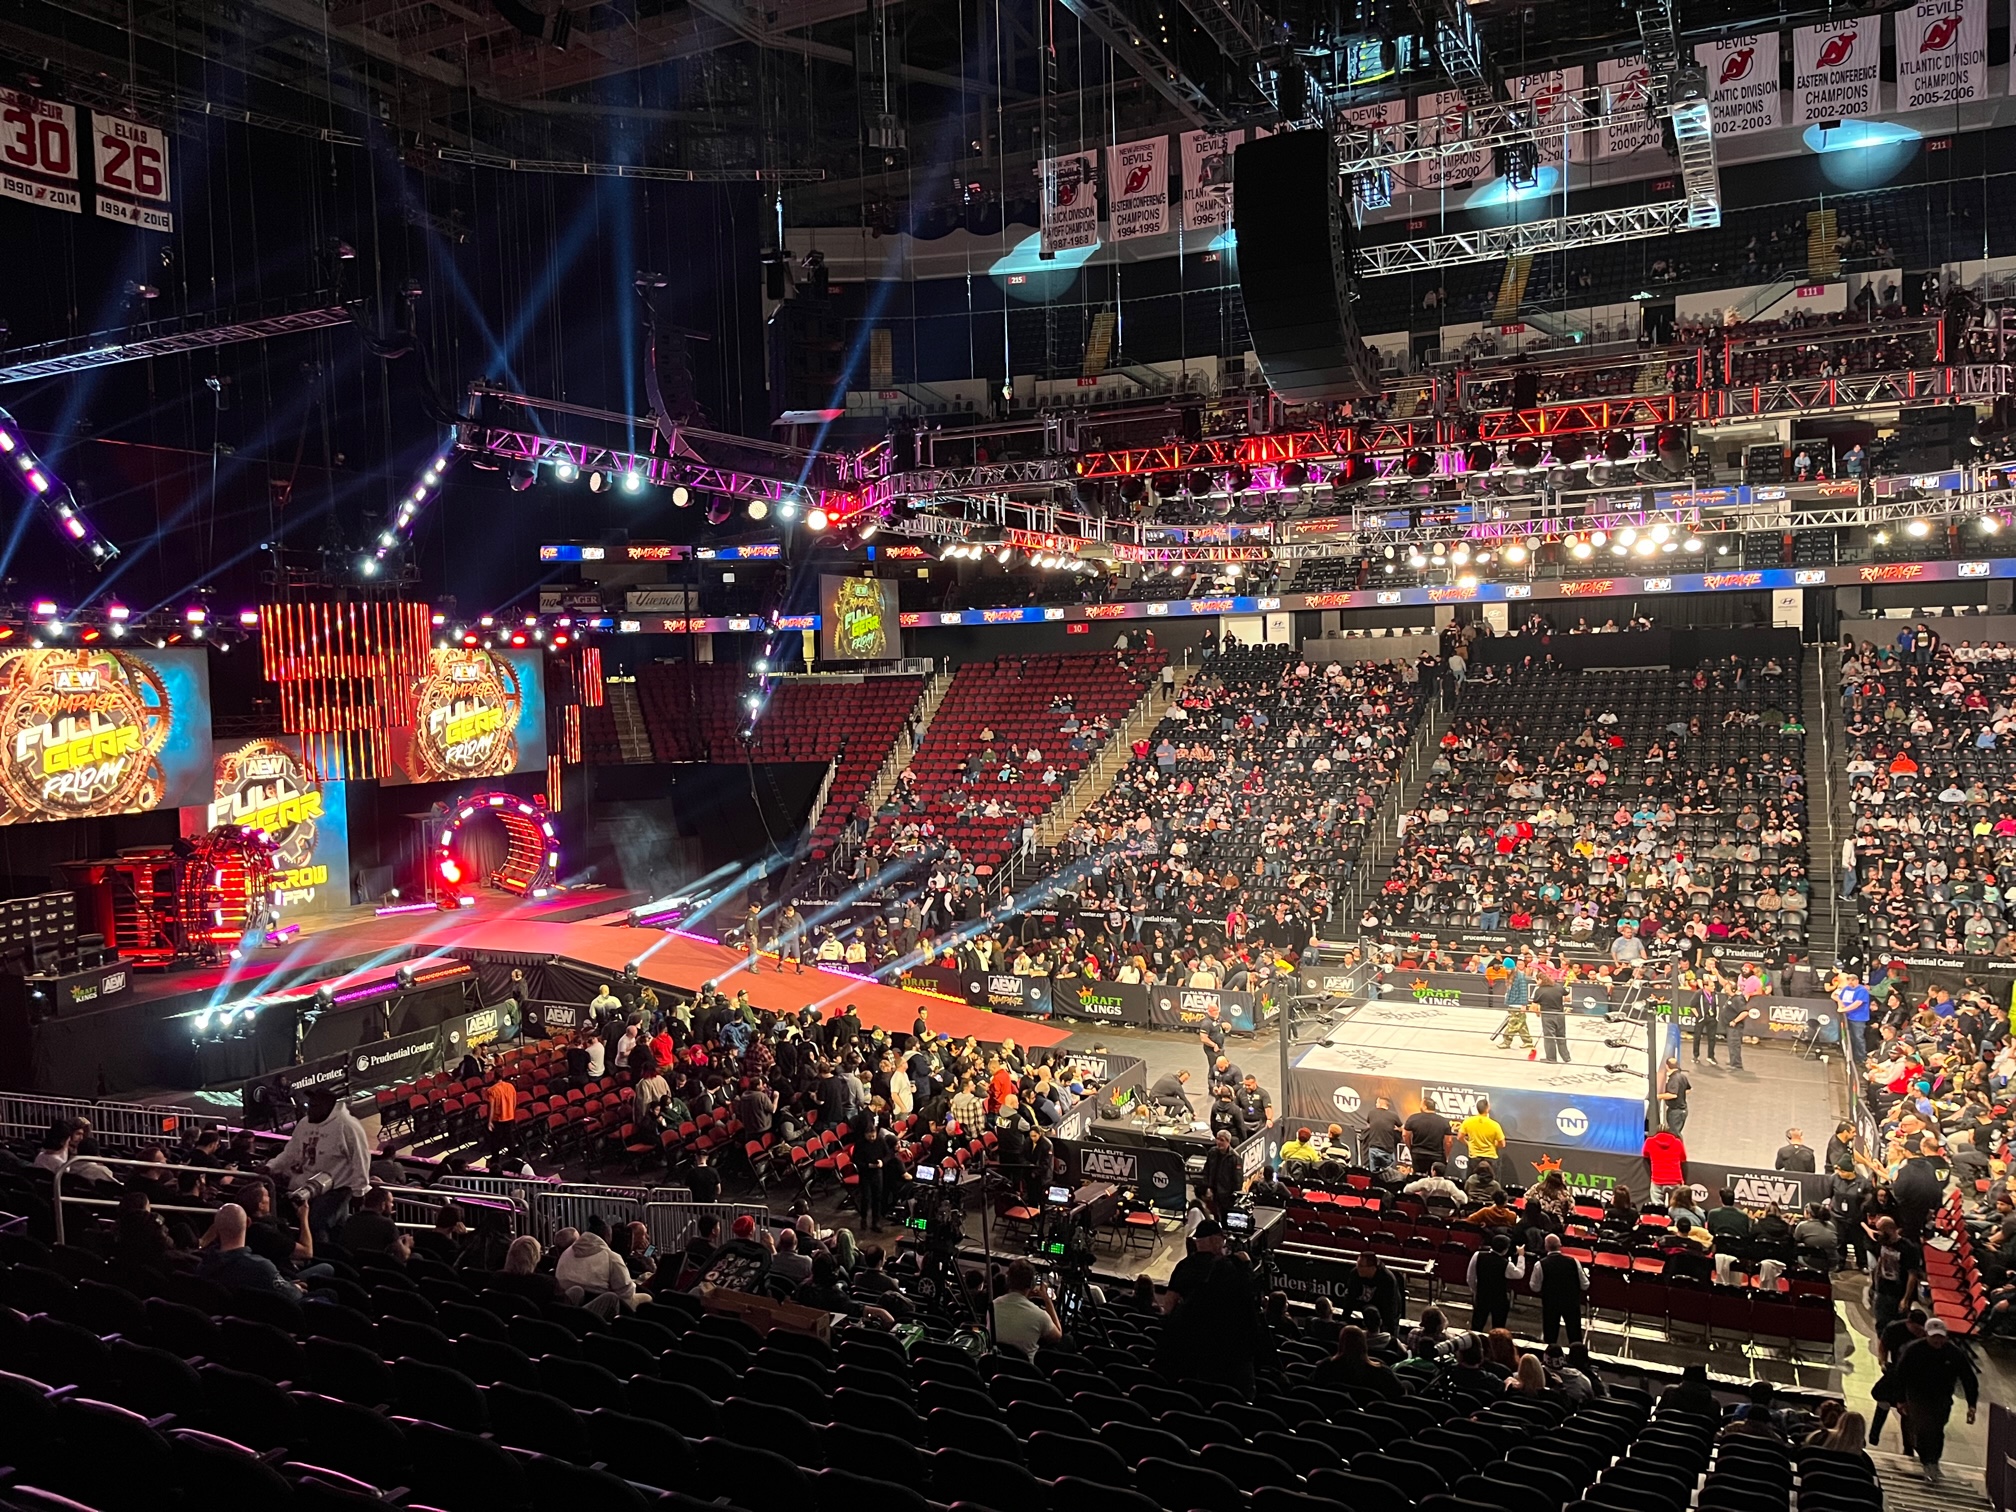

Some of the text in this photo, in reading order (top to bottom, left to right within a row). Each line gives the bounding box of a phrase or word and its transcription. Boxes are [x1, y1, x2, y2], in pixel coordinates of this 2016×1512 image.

[1917, 2, 1963, 18] DEVILS
[1814, 17, 1859, 34] DEVILS
[1716, 35, 1758, 50] DEVILS
[1618, 55, 1647, 68] DEVI
[1900, 48, 1985, 76] ATLANTIC DIVISION
[1797, 65, 1877, 89] EASTERN CONFERENCE
[1915, 71, 1969, 91] CHAMPIONS
[1713, 80, 1778, 102] ANTIC DIVISION
[1805, 84, 1868, 105] CHAMPIONS
[1909, 86, 1974, 107] 2005-2006
[1713, 100, 1764, 119] CHAMPIONS
[1805, 102, 1868, 120] 2002-2003
[1609, 119, 1659, 138] CHAMPION
[1714, 115, 1772, 133] 002-2003
[4, 109, 71, 175] 30
[115, 123, 148, 144] ELIAS
[1119, 143, 1156, 155] NEW JERSEY
[1196, 138, 1228, 153] DEVILS
[1610, 133, 1660, 152] 2000-200
[1931, 142, 1946, 150] 211
[102, 135, 163, 196] 26
[1122, 152, 1153, 167] DEVILS
[1428, 151, 1481, 171] CHAMPIONS
[4, 177, 77, 205] 1990 2014
[101, 201, 169, 227] 1994 2016
[1068, 206, 1095, 221] DIVISION
[1117, 208, 1160, 226] CHAMPIONS
[1117, 222, 1160, 238] 1994-1995
[1803, 287, 1818, 296] 111
[1797, 571, 1824, 583] AEW
[1860, 565, 1923, 583] RAMPAGE
[1960, 563, 1988, 577] AEW
[1560, 580, 1613, 597] RAMPAGE
[1645, 578, 1670, 591] AEW
[1704, 572, 1762, 589] RAMPAGE
[1305, 594, 1351, 608] RAMPAGE
[1428, 587, 1477, 602] RAMPAGE
[1085, 605, 1125, 618] RAMPAGE
[1191, 600, 1234, 613] RAMPAGE
[845, 606, 872, 630] FULL
[983, 610, 1024, 622] RAMPAGE
[852, 615, 880, 637] GEAR
[57, 672, 96, 688] AEW
[455, 666, 477, 678] AEW
[34, 693, 121, 719] RAMPAGE
[430, 696, 489, 735] FULL
[446, 708, 506, 744] GEAR
[16, 711, 116, 762] FULL
[43, 725, 144, 774] GEAR
[446, 732, 495, 763] FRIDAY
[247, 758, 283, 776] AEW
[43, 757, 126, 800] FRIDAY
[208, 779, 300, 832] FULL
[233, 791, 325, 834] GEAR
[1462, 934, 1507, 943] prucenter.com
[1937, 958, 1965, 968] Center
[104, 975, 124, 991] AEW
[901, 977, 938, 987] DRAFT
[991, 977, 1020, 993] AEW
[75, 992, 98, 1003] KINGS
[987, 994, 1023, 1007] RAMPAGE
[1080, 995, 1123, 1006] DRAFT
[1183, 994, 1218, 1009] AEW
[1413, 988, 1462, 999] DRAFT
[1418, 996, 1461, 1006] KINGS
[547, 1008, 574, 1024] AEW
[1085, 1003, 1122, 1016] KINGS
[1180, 1012, 1206, 1023] RAMP
[1772, 1008, 1806, 1021] AEW
[468, 1013, 495, 1033] AEW
[371, 1041, 435, 1066] Prudential Center
[291, 1068, 344, 1090] ential Center
[1333, 1094, 1361, 1107] TNT
[1430, 1091, 1486, 1116] AEW
[1557, 1117, 1588, 1129] TNT
[1084, 1153, 1134, 1177] AEW
[1243, 1141, 1264, 1173] AEW
[1091, 1172, 1128, 1182] WRESTLING
[1153, 1176, 1169, 1185] TNT
[1761, 1175, 1785, 1183] ELITE
[1734, 1178, 1798, 1205] AEW
[1740, 1199, 1789, 1210] WRESTNG
[1271, 1273, 1331, 1295] udential
